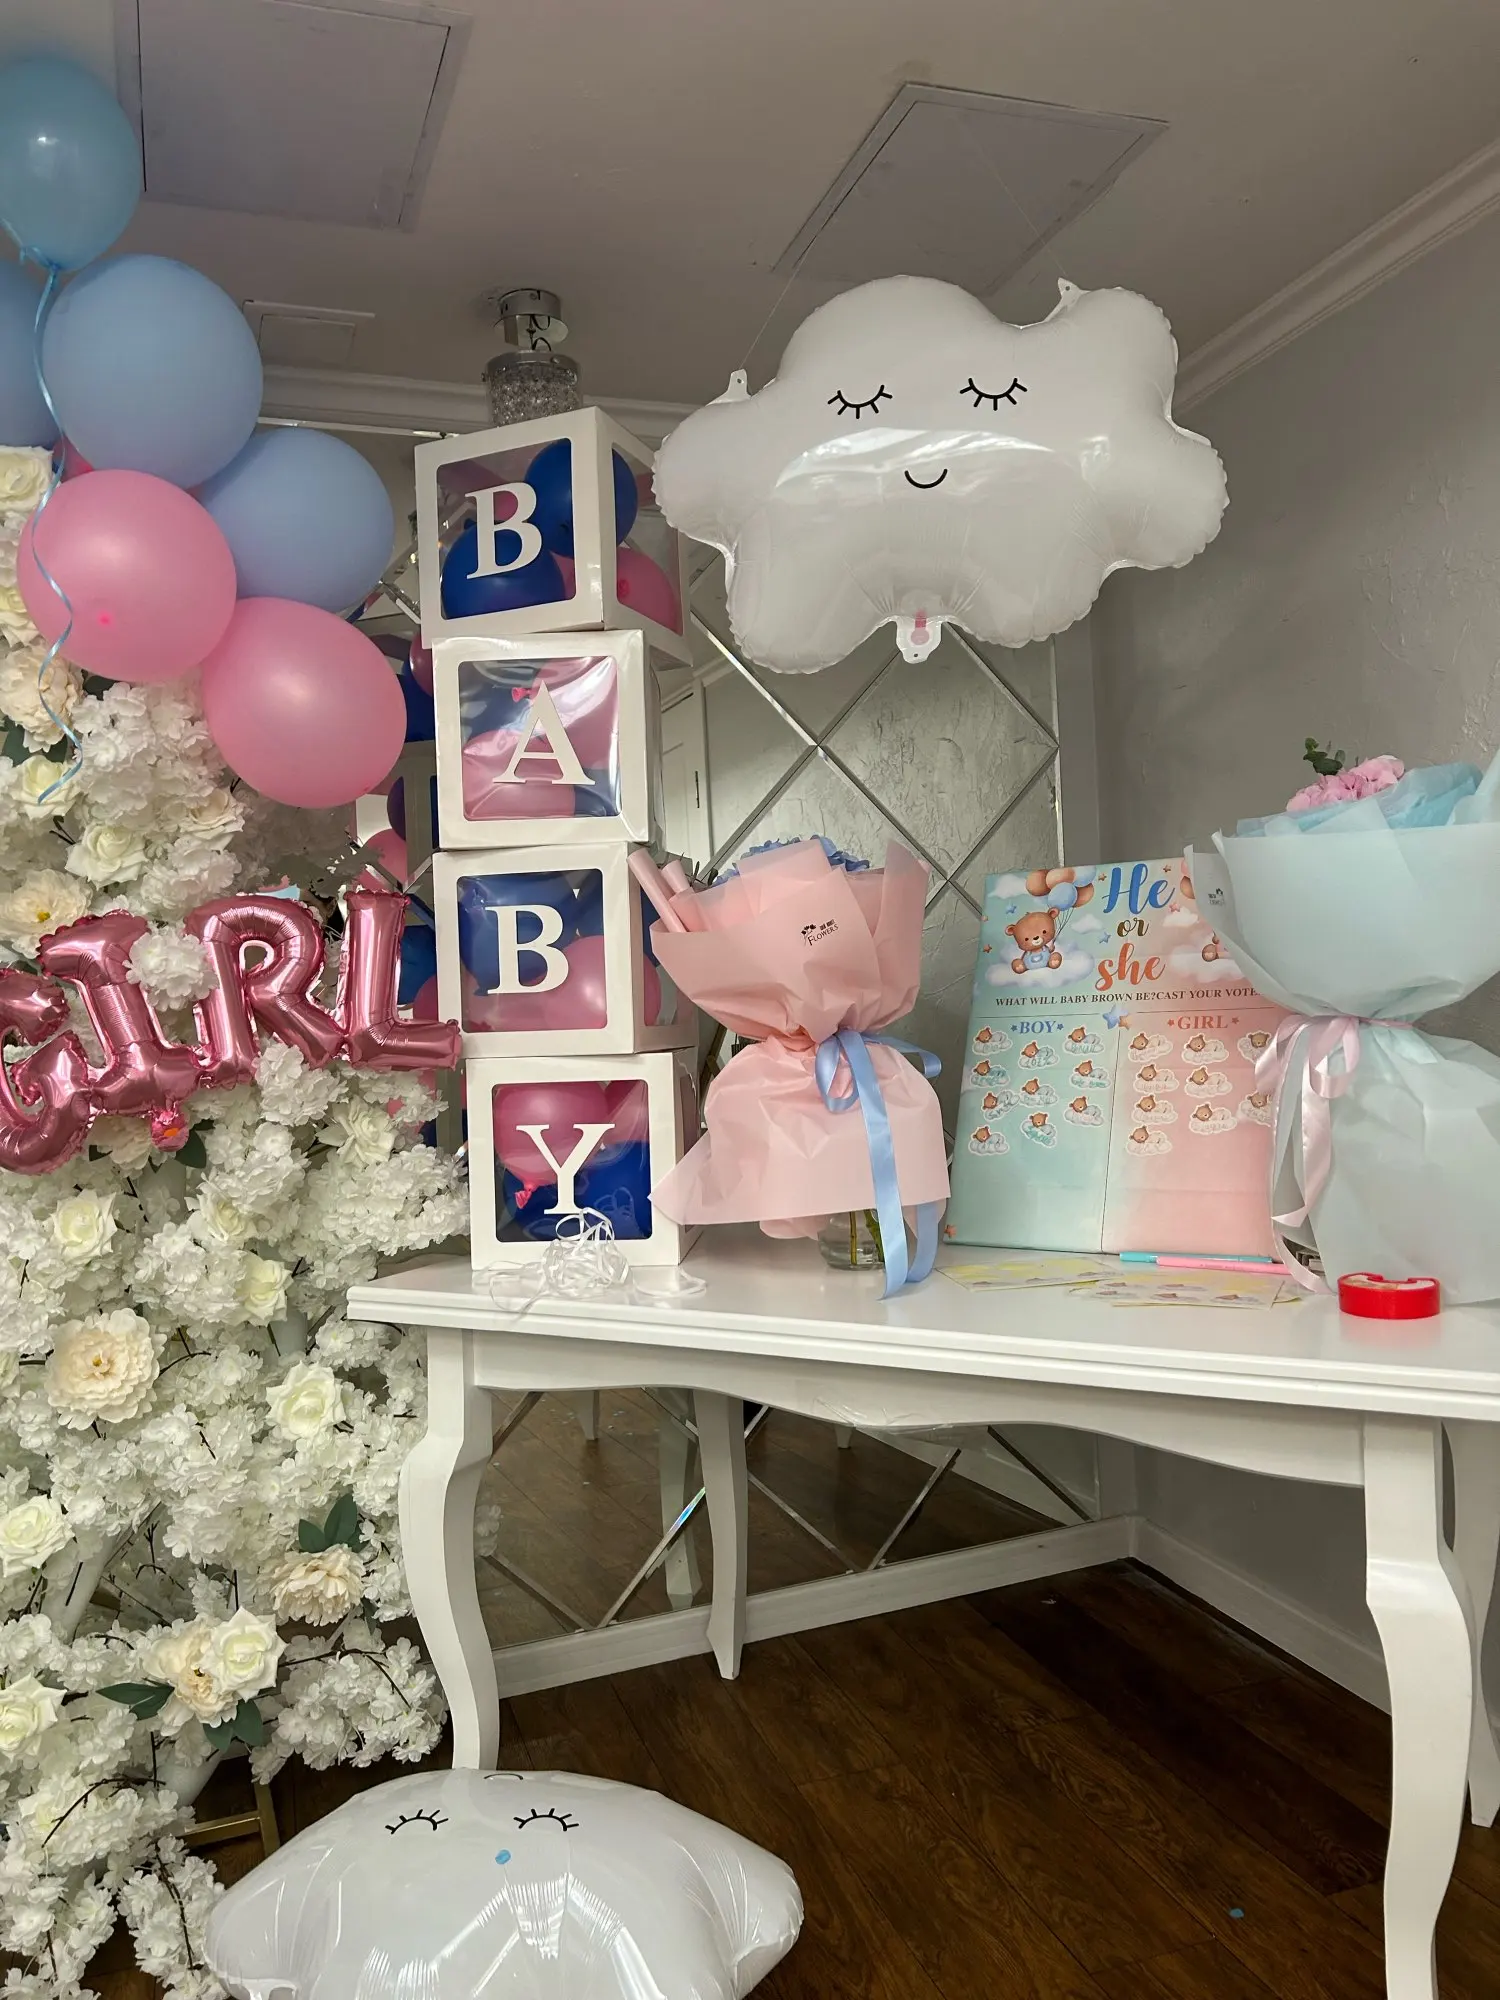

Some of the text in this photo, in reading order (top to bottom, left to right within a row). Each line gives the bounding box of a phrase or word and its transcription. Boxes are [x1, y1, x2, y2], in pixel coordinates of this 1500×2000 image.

[1102, 863, 1175, 915] He
[1117, 917, 1149, 937] or
[1095, 942, 1166, 991] she
[995, 997, 1027, 1006] WHAT
[1030, 996, 1058, 1005] WILL
[1060, 994, 1088, 1004] BABY
[1091, 992, 1133, 1003] BROWN
[1189, 988, 1222, 999] YOUR
[0, 888, 463, 1175] GIRL
[1020, 1020, 1056, 1034] BOY
[1177, 1015, 1228, 1030] GIRL
